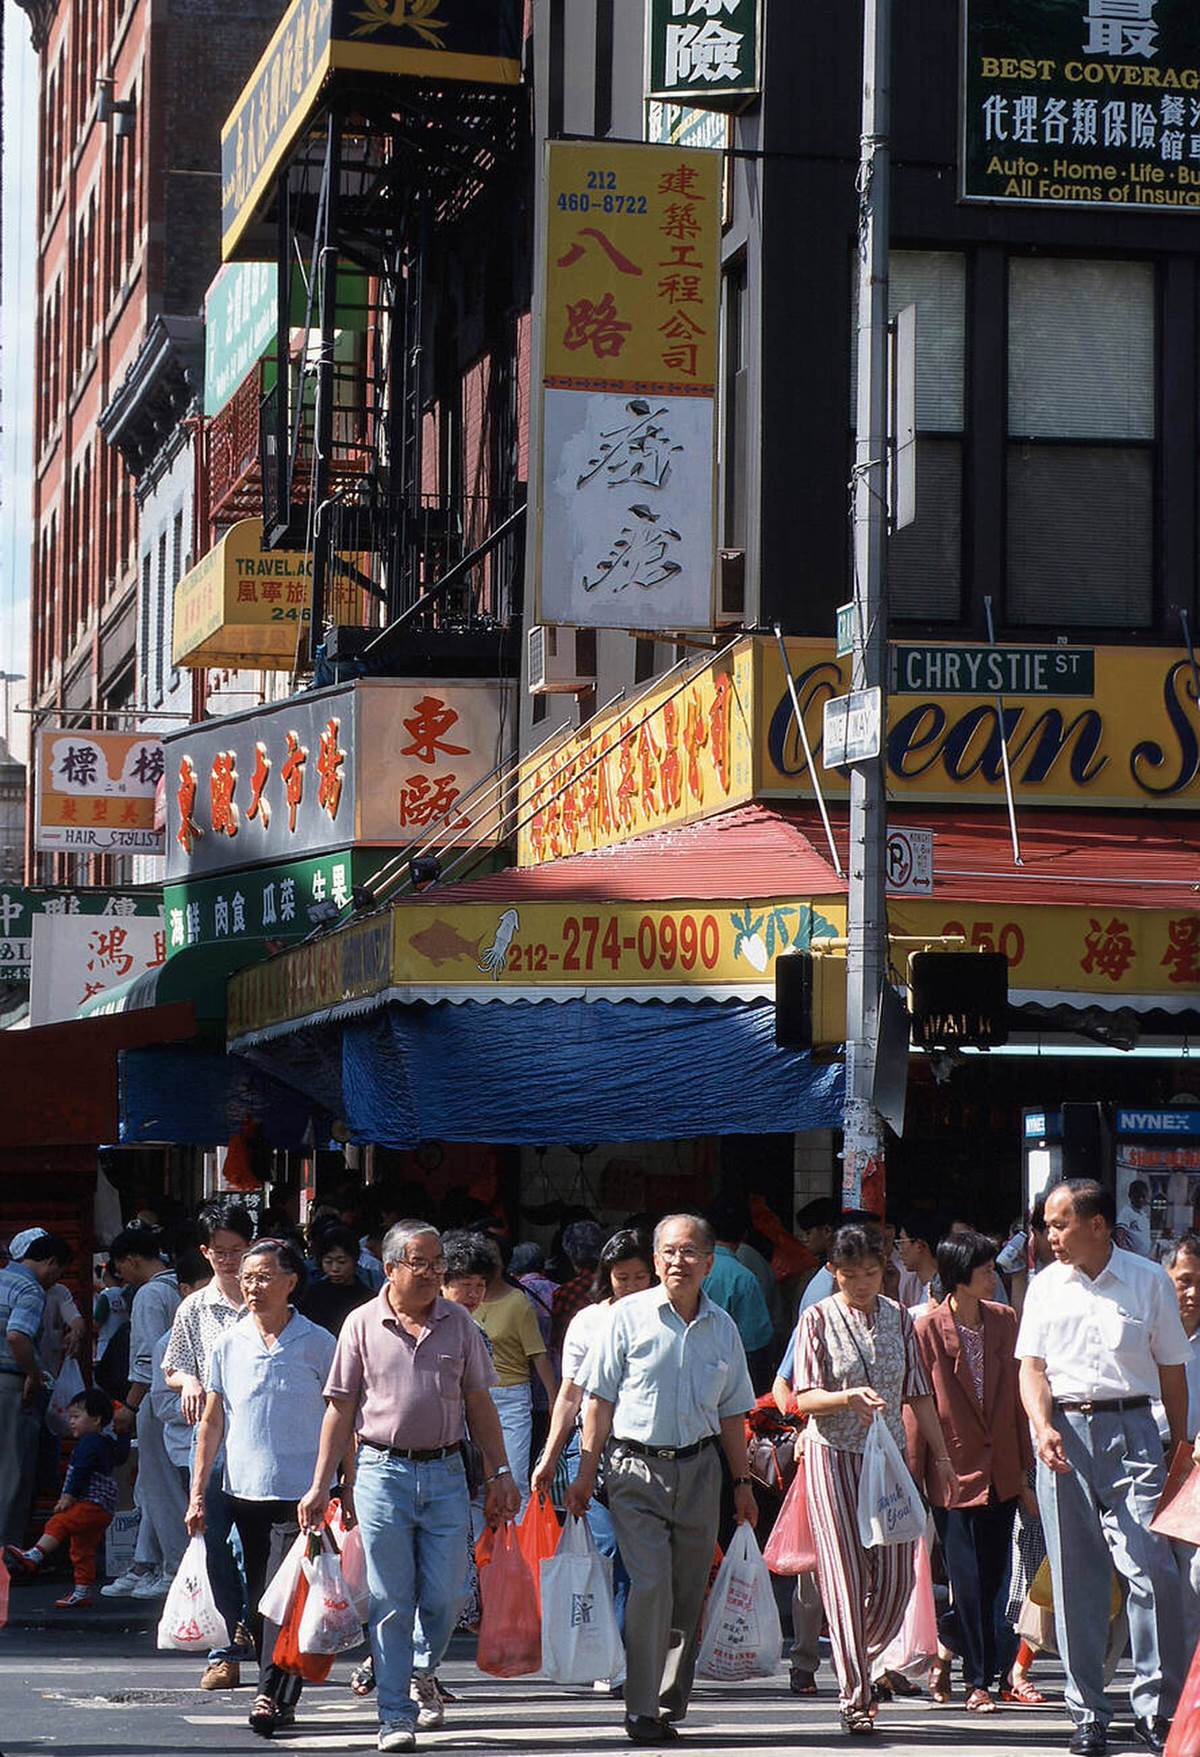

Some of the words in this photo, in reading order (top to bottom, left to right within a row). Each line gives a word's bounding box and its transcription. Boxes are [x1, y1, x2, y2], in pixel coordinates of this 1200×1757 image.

[1083, 0, 1159, 58] 最
[981, 57, 1056, 80] BEST
[1065, 62, 1200, 89] COVERAG
[982, 95, 1157, 149] 代理各類保險
[587, 171, 617, 189] 212
[987, 156, 1038, 175] Auto
[1053, 160, 1117, 180] Home
[1130, 164, 1164, 182] Life
[557, 193, 647, 214] 460-8722
[1005, 179, 1032, 197] All
[1040, 180, 1102, 200] Forms
[1108, 184, 1129, 202] of
[658, 163, 706, 376] 建築工程公司
[557, 227, 643, 359] 八路
[906, 651, 1048, 691] CHRYSTIE
[1055, 656, 1080, 674] ST
[768, 661, 1111, 785] Oean
[65, 830, 97, 845] HAIR
[109, 831, 163, 846] STYLIST
[1121, 1113, 1190, 1130] NYNEX
